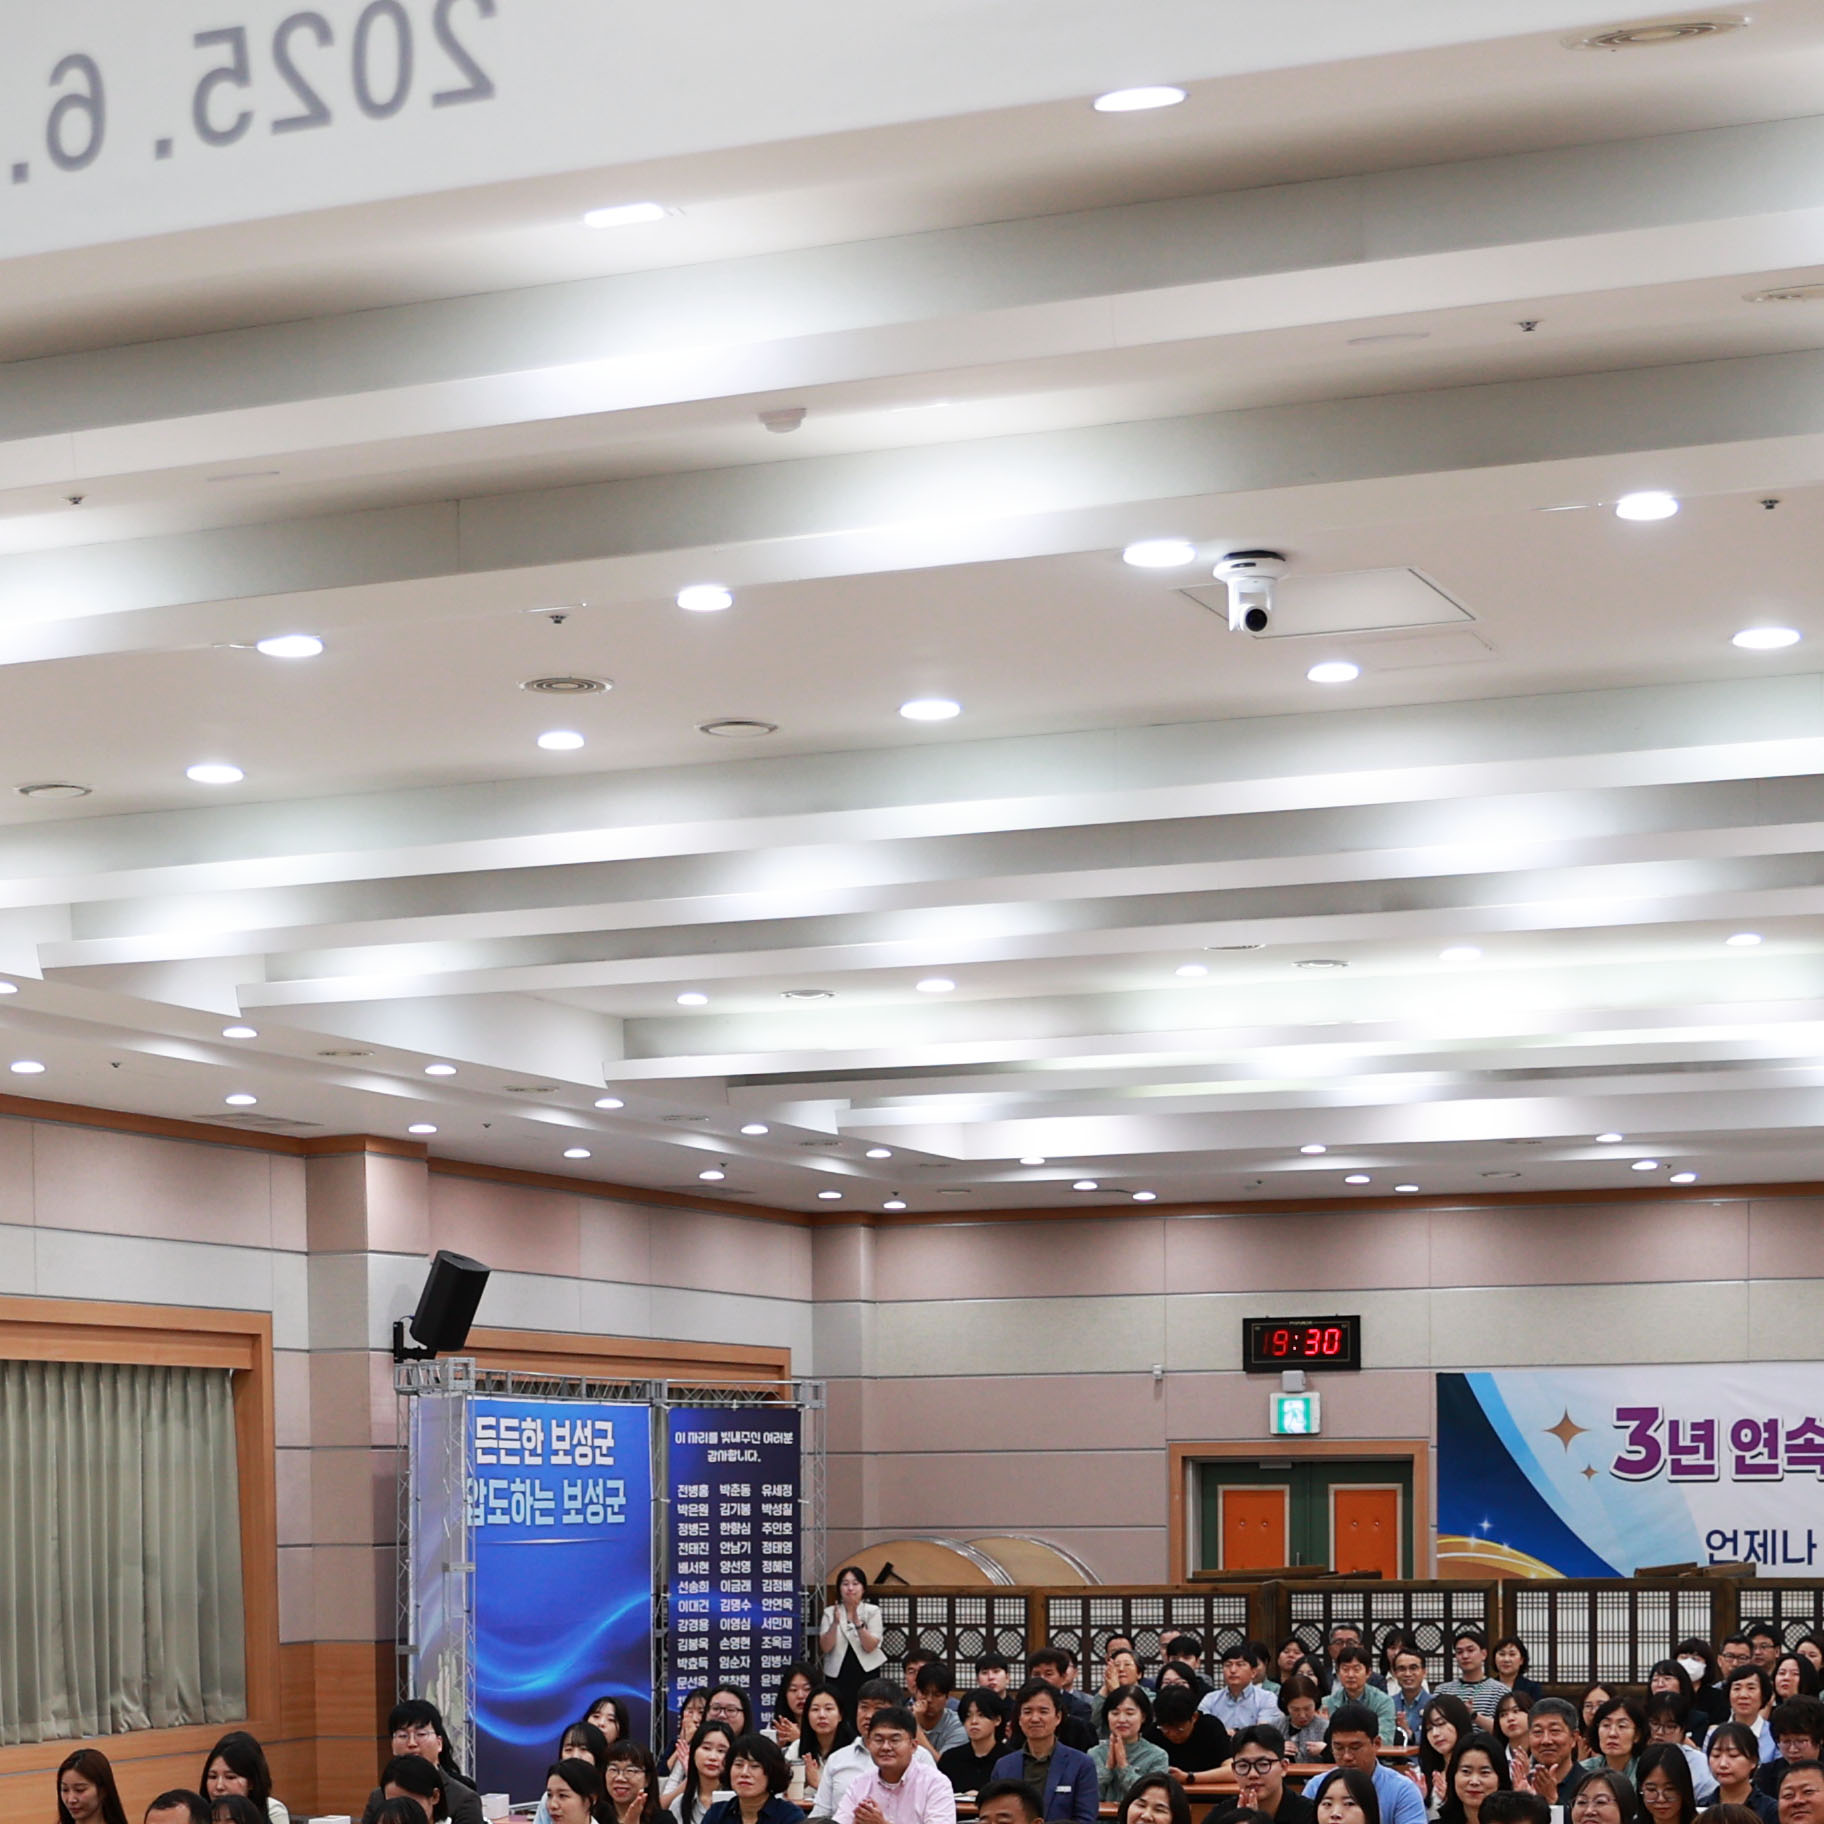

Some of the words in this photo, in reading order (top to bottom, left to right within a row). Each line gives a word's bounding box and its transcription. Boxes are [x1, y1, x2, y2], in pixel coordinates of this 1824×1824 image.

[474, 1417, 545, 1466] 든든한
[550, 1418, 615, 1466] 보성군
[674, 1431, 686, 1445] 이
[762, 1431, 794, 1445] 여러분
[707, 1448, 762, 1463] 감사합니다.
[1607, 1403, 1721, 1482] 3년
[466, 1477, 556, 1526] 압도하는
[561, 1477, 627, 1525] 보성군
[1705, 1528, 1818, 1566] 언제나
